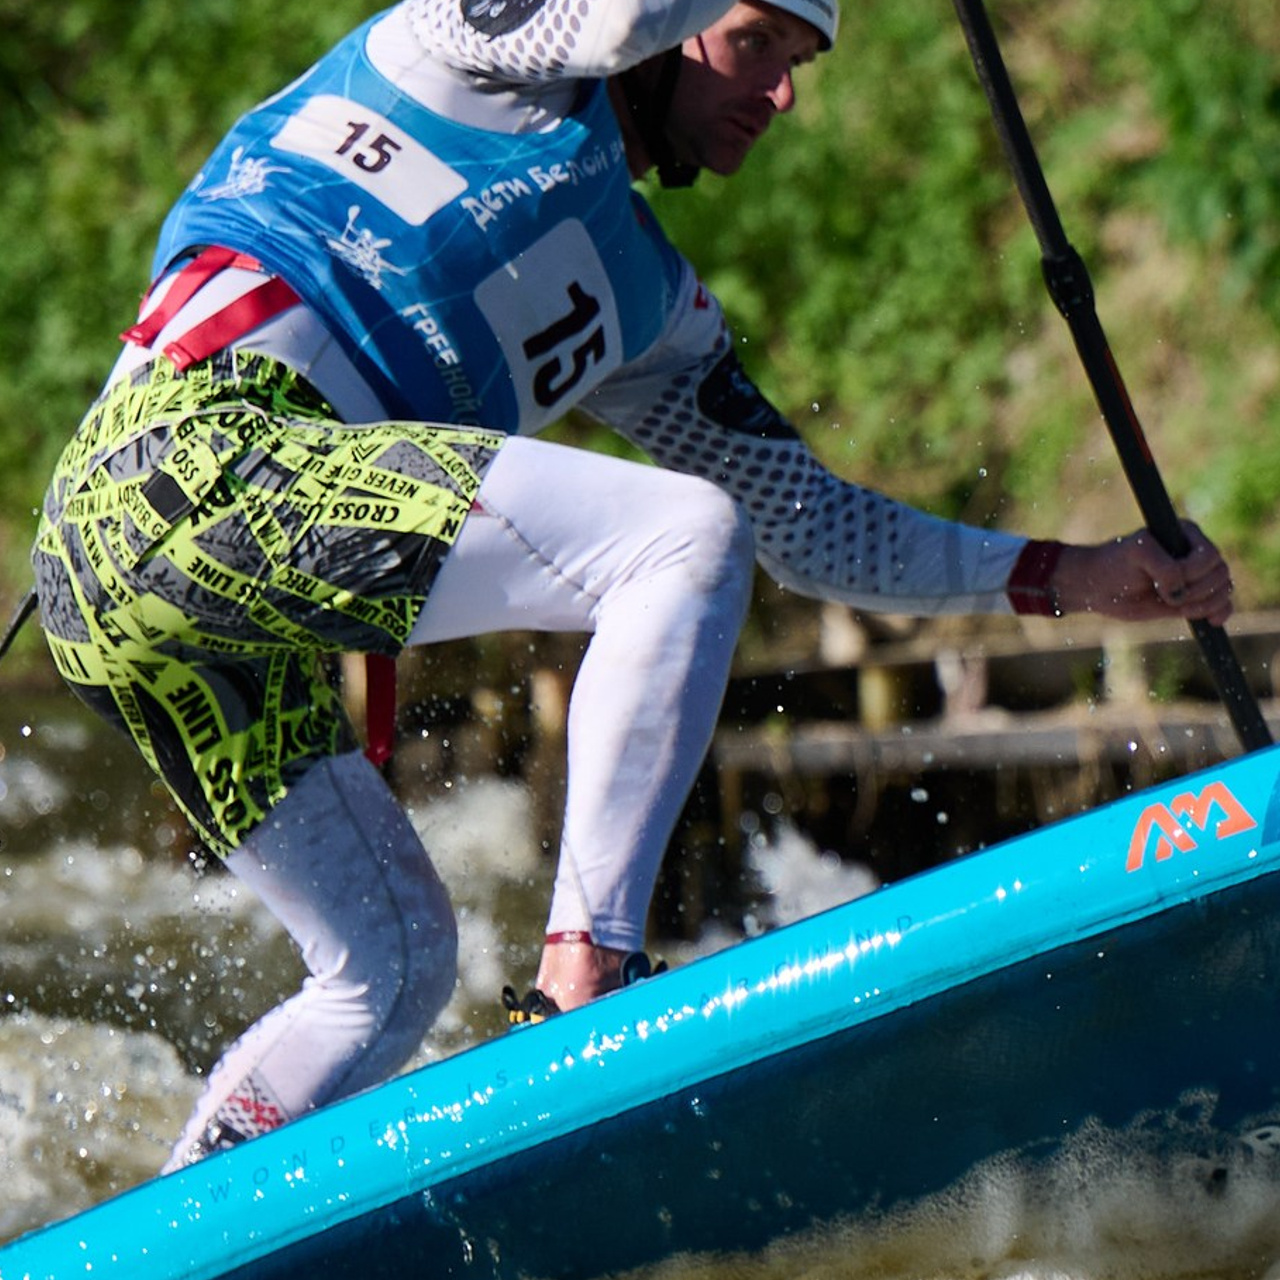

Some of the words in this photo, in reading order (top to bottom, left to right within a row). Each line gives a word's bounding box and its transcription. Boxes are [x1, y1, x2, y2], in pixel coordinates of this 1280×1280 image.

[334, 121, 402, 173] 15
[460, 178, 532, 231] Дети
[522, 281, 606, 407] 15
[326, 463, 362, 481] GIVE
[363, 470, 420, 499] NEVER
[330, 502, 400, 524] CROSS
[186, 556, 236, 593] LINE
[278, 569, 319, 597] TREC
[379, 610, 408, 637] OSS
[165, 679, 223, 755] LINE
